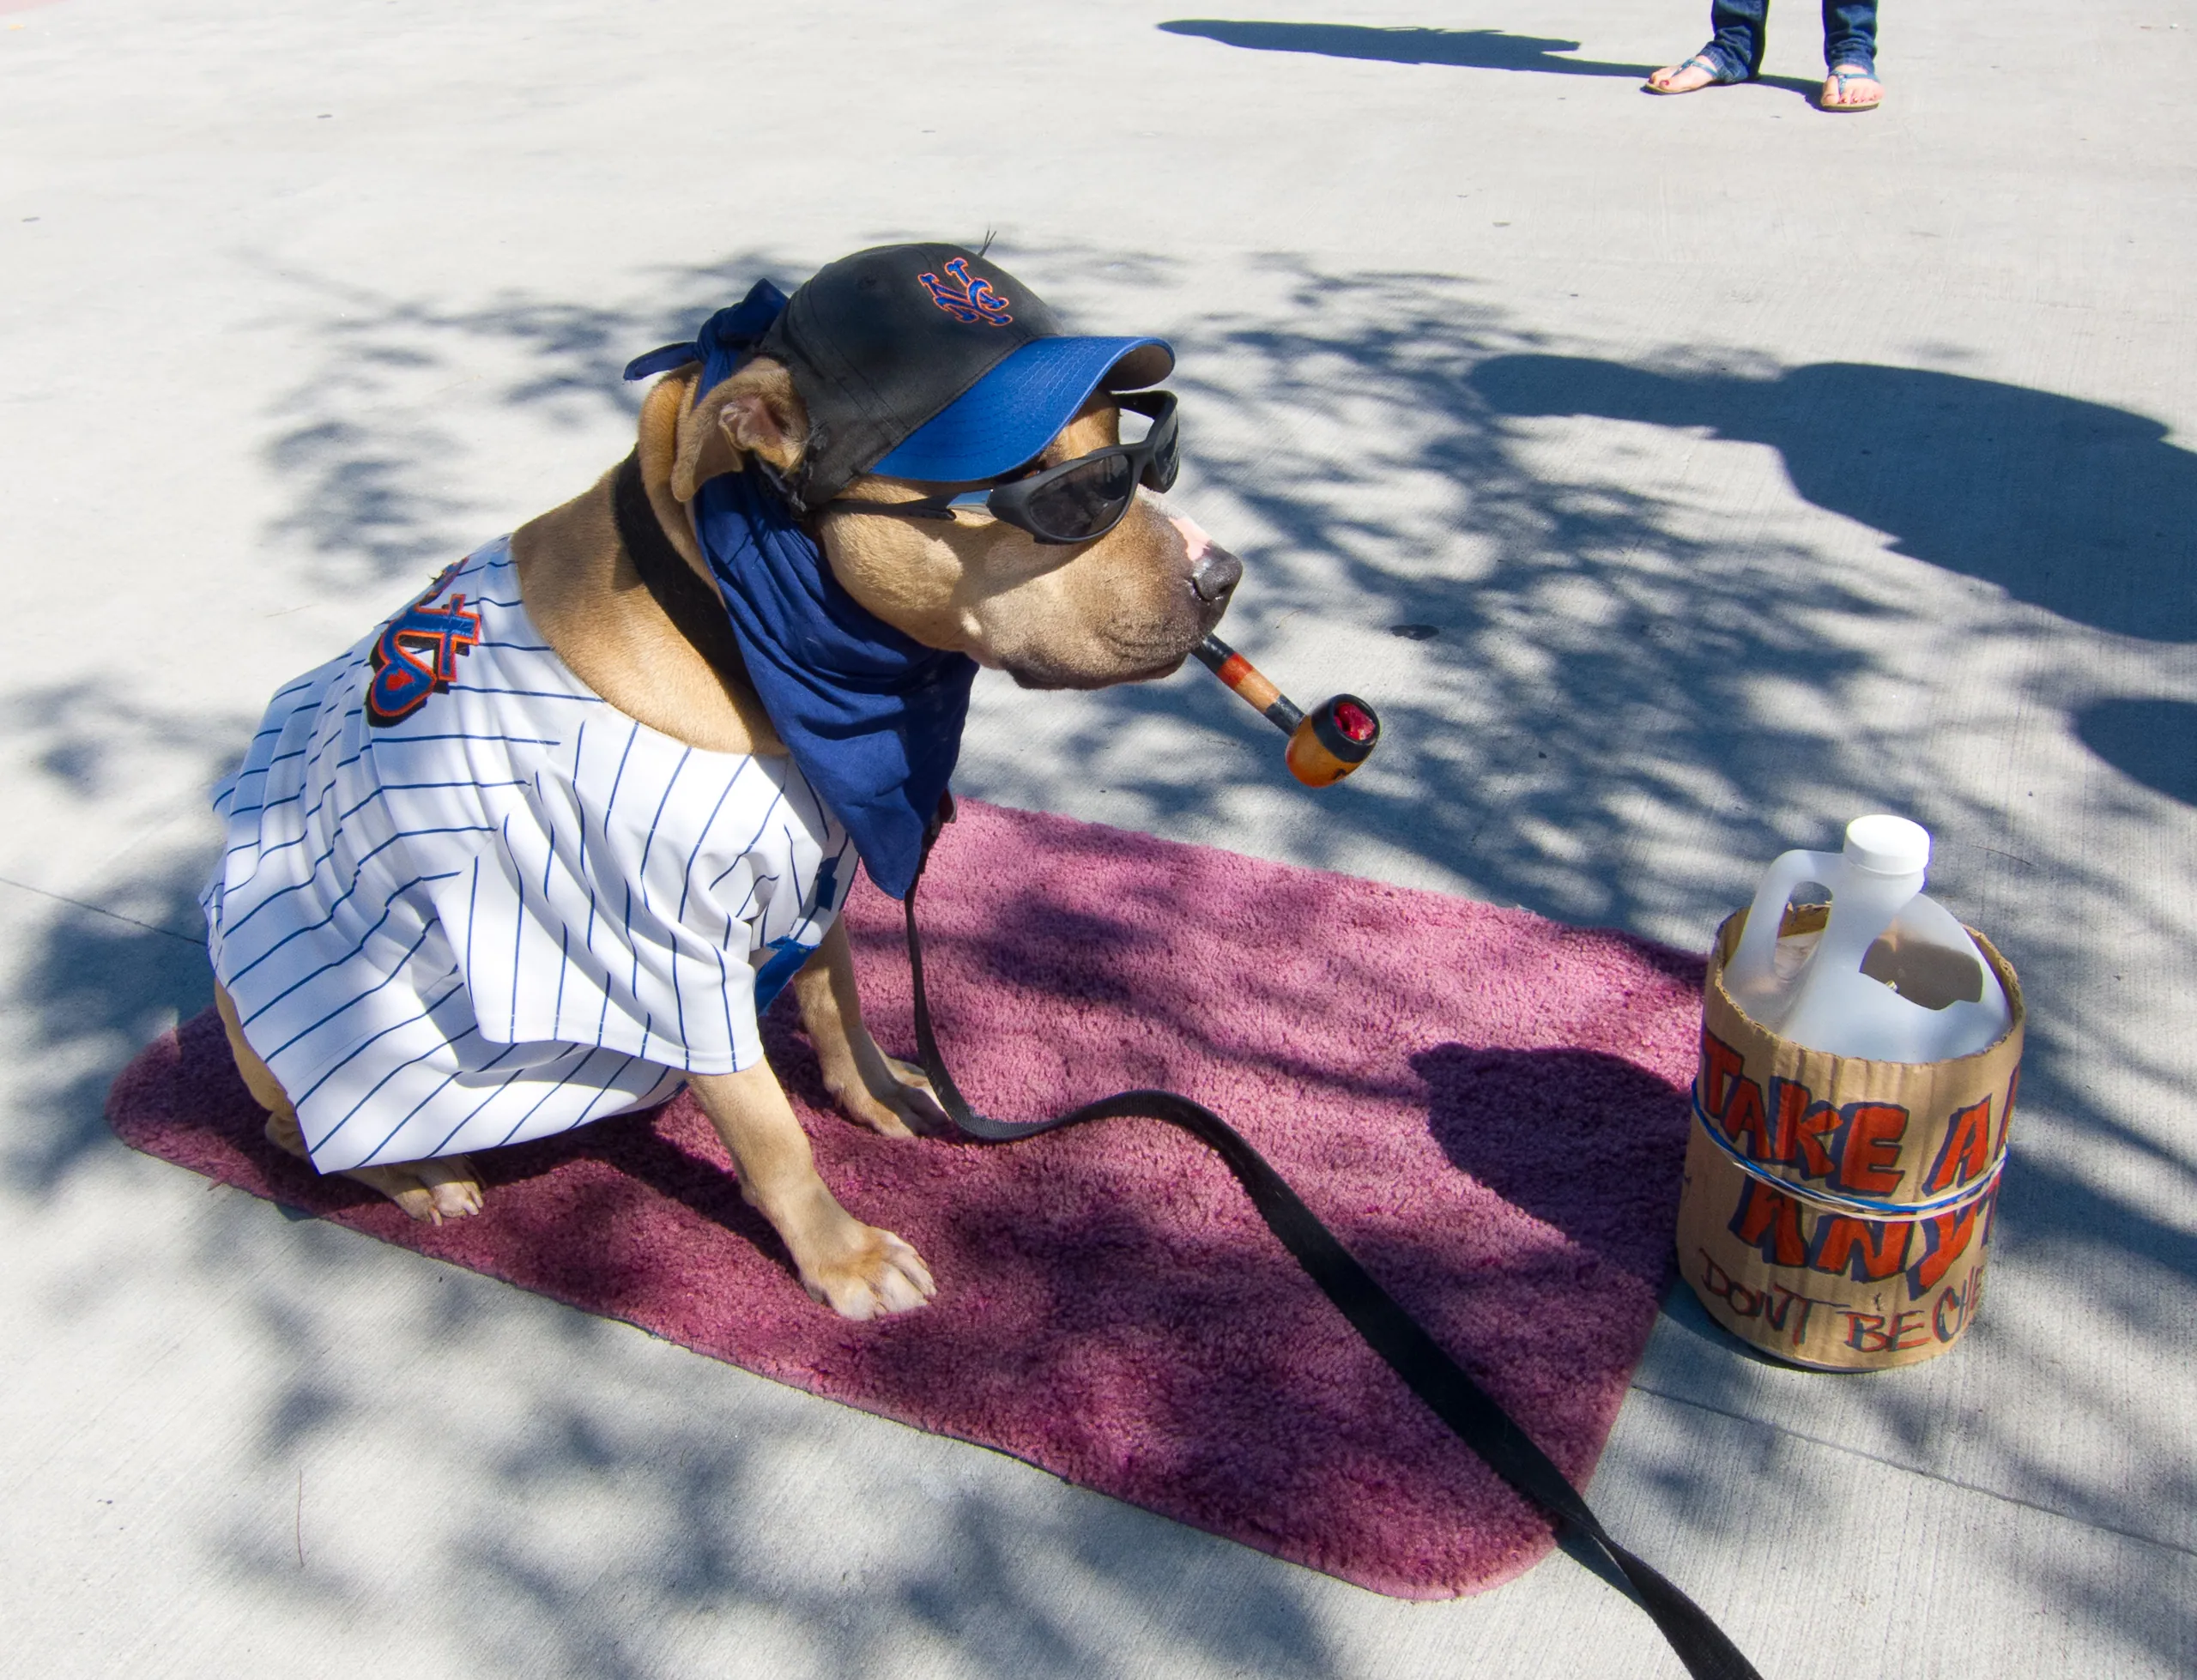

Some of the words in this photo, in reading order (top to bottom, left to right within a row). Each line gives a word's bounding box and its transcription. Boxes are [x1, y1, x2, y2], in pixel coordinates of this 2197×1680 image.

[1700, 1024, 1910, 1199] TAKE
[1698, 1247, 1852, 1347] DONT
[1836, 1308, 1932, 1353] BE
